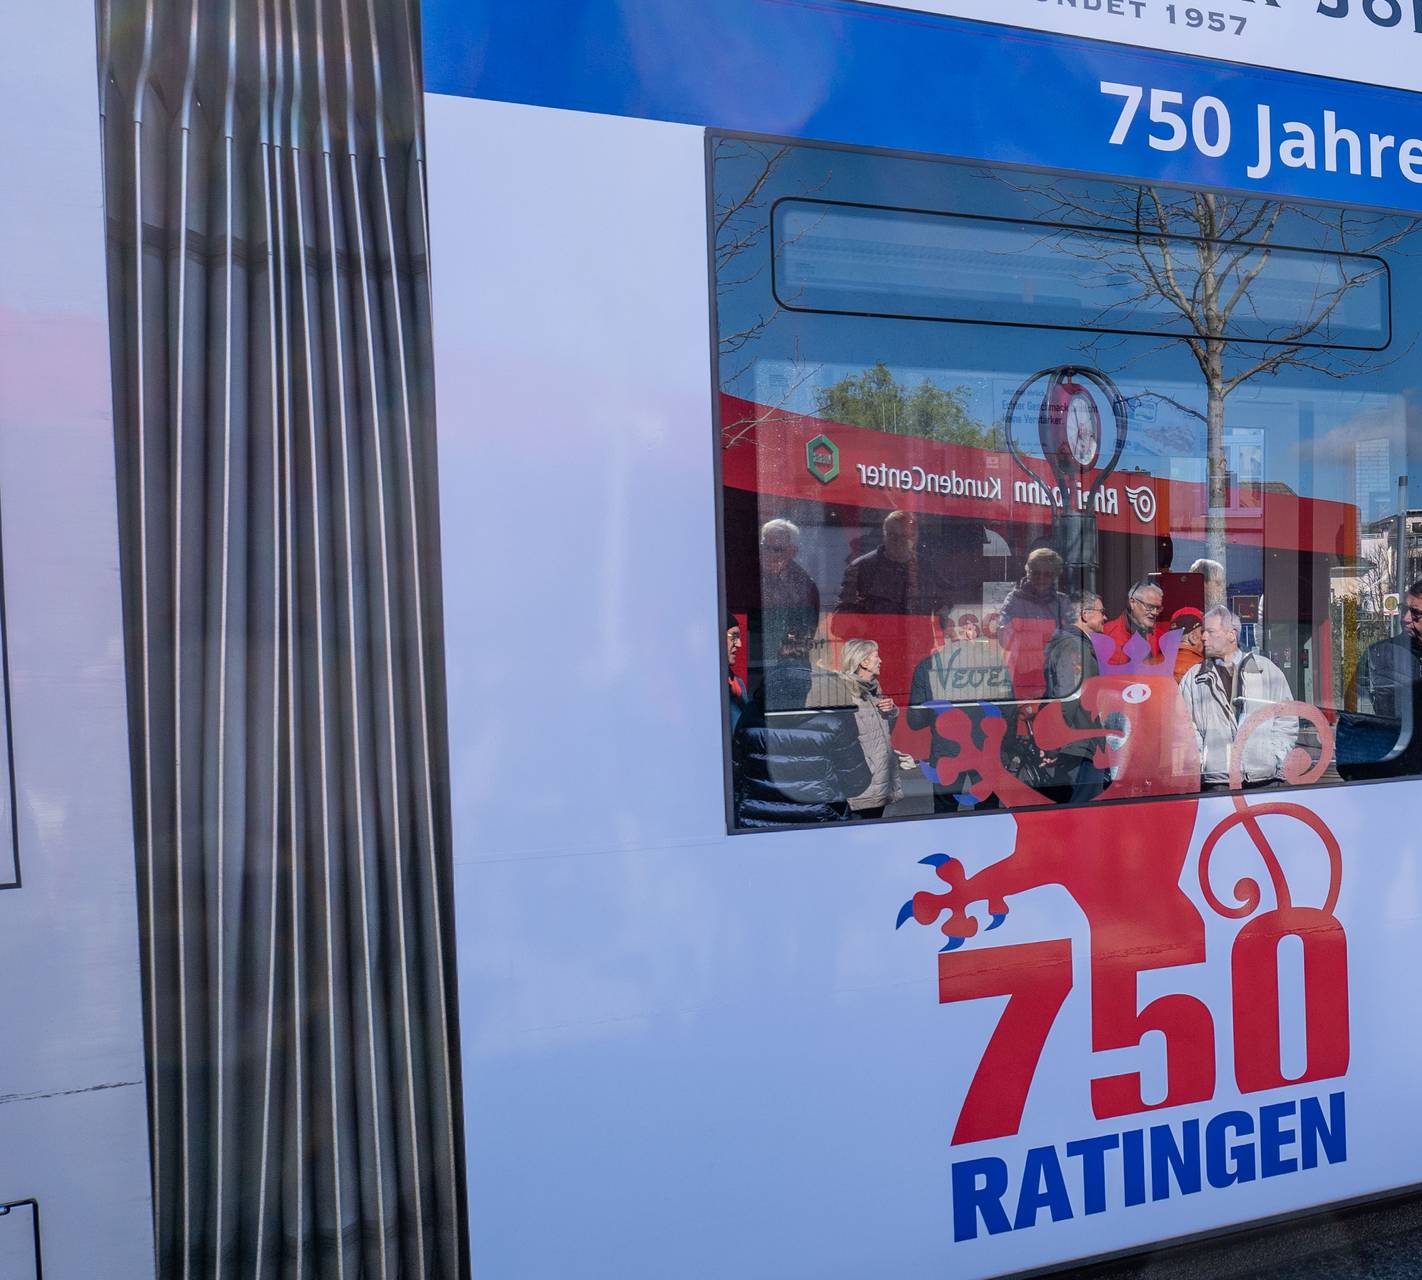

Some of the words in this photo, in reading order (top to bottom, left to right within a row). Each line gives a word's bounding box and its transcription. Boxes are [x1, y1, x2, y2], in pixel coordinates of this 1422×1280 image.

[1166, 4, 1248, 36] 1957
[1099, 81, 1231, 158] 750
[938, 906, 1351, 1147] 750
[950, 1091, 1348, 1244] RATINGEN
